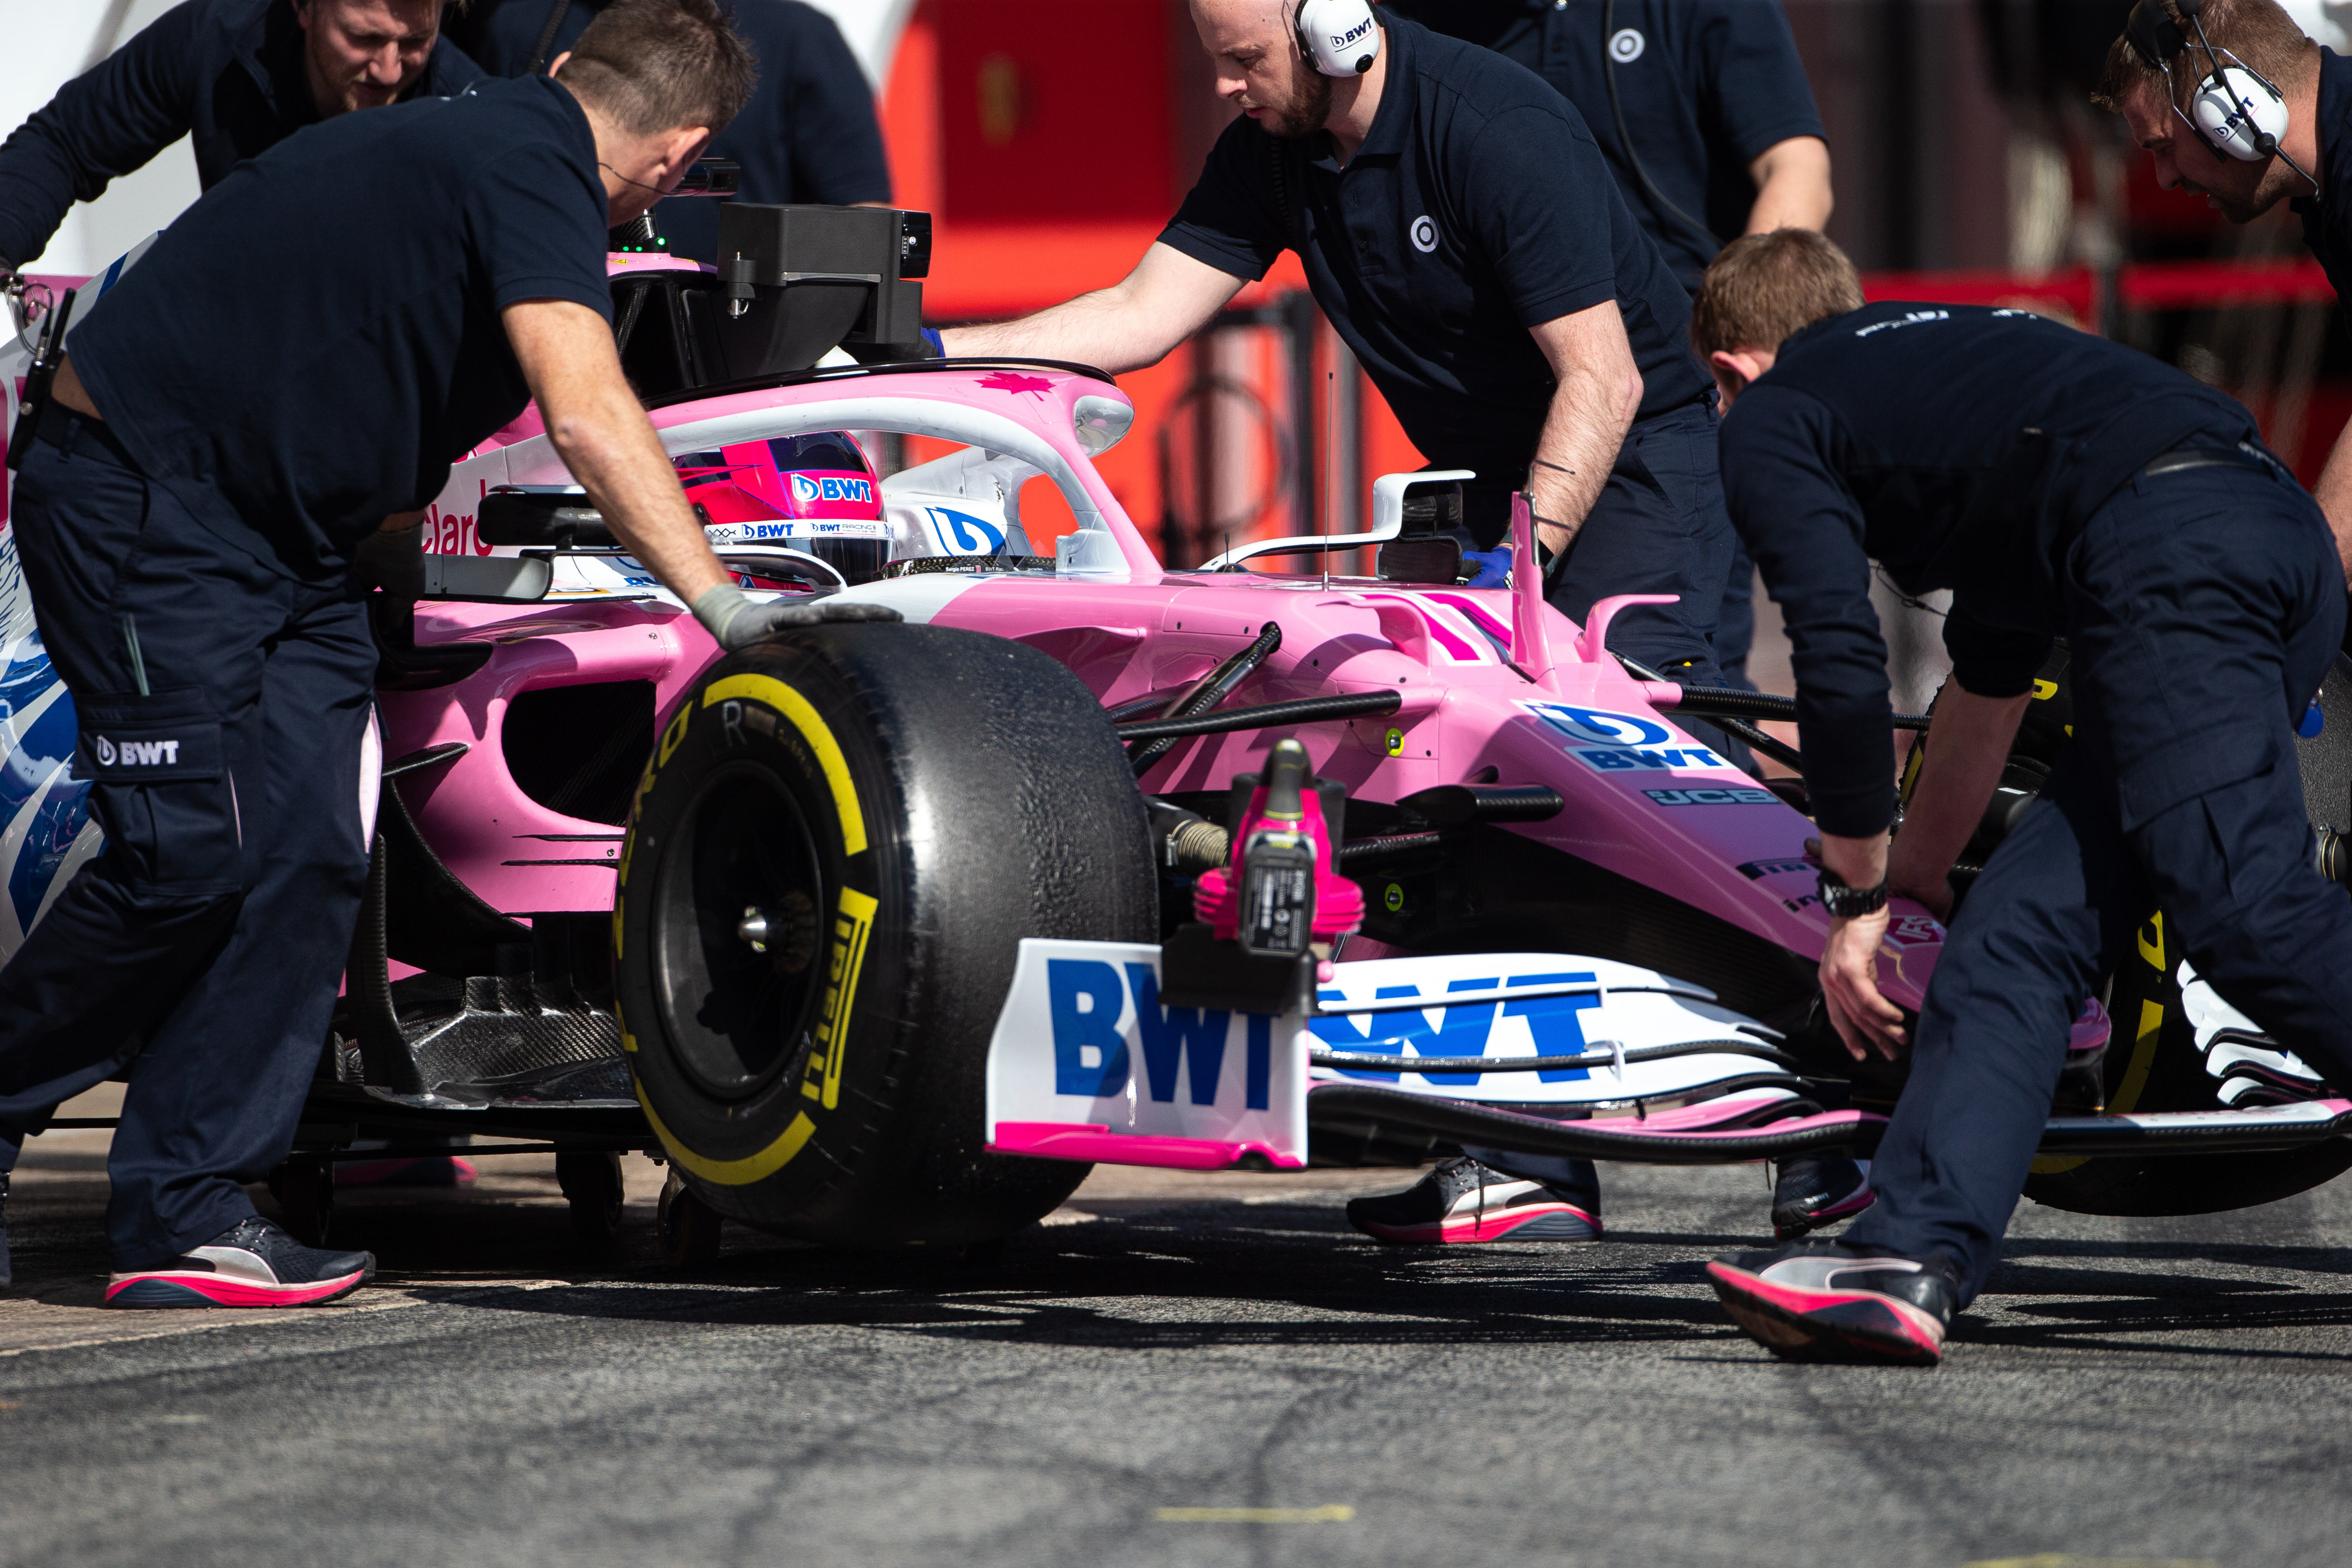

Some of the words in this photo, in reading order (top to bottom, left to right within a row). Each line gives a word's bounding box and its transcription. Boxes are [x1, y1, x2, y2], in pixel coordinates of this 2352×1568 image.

[1345, 17, 1372, 43] BWT
[820, 478, 872, 502] BWT
[757, 524, 794, 537] BWT
[119, 740, 179, 765] BWT
[1578, 749, 1724, 769] BWT
[1646, 790, 1780, 805] JCB
[800, 886, 879, 1110] PIRELLI
[1048, 959, 1282, 1111] BWT
[1308, 972, 1602, 1086] WT
